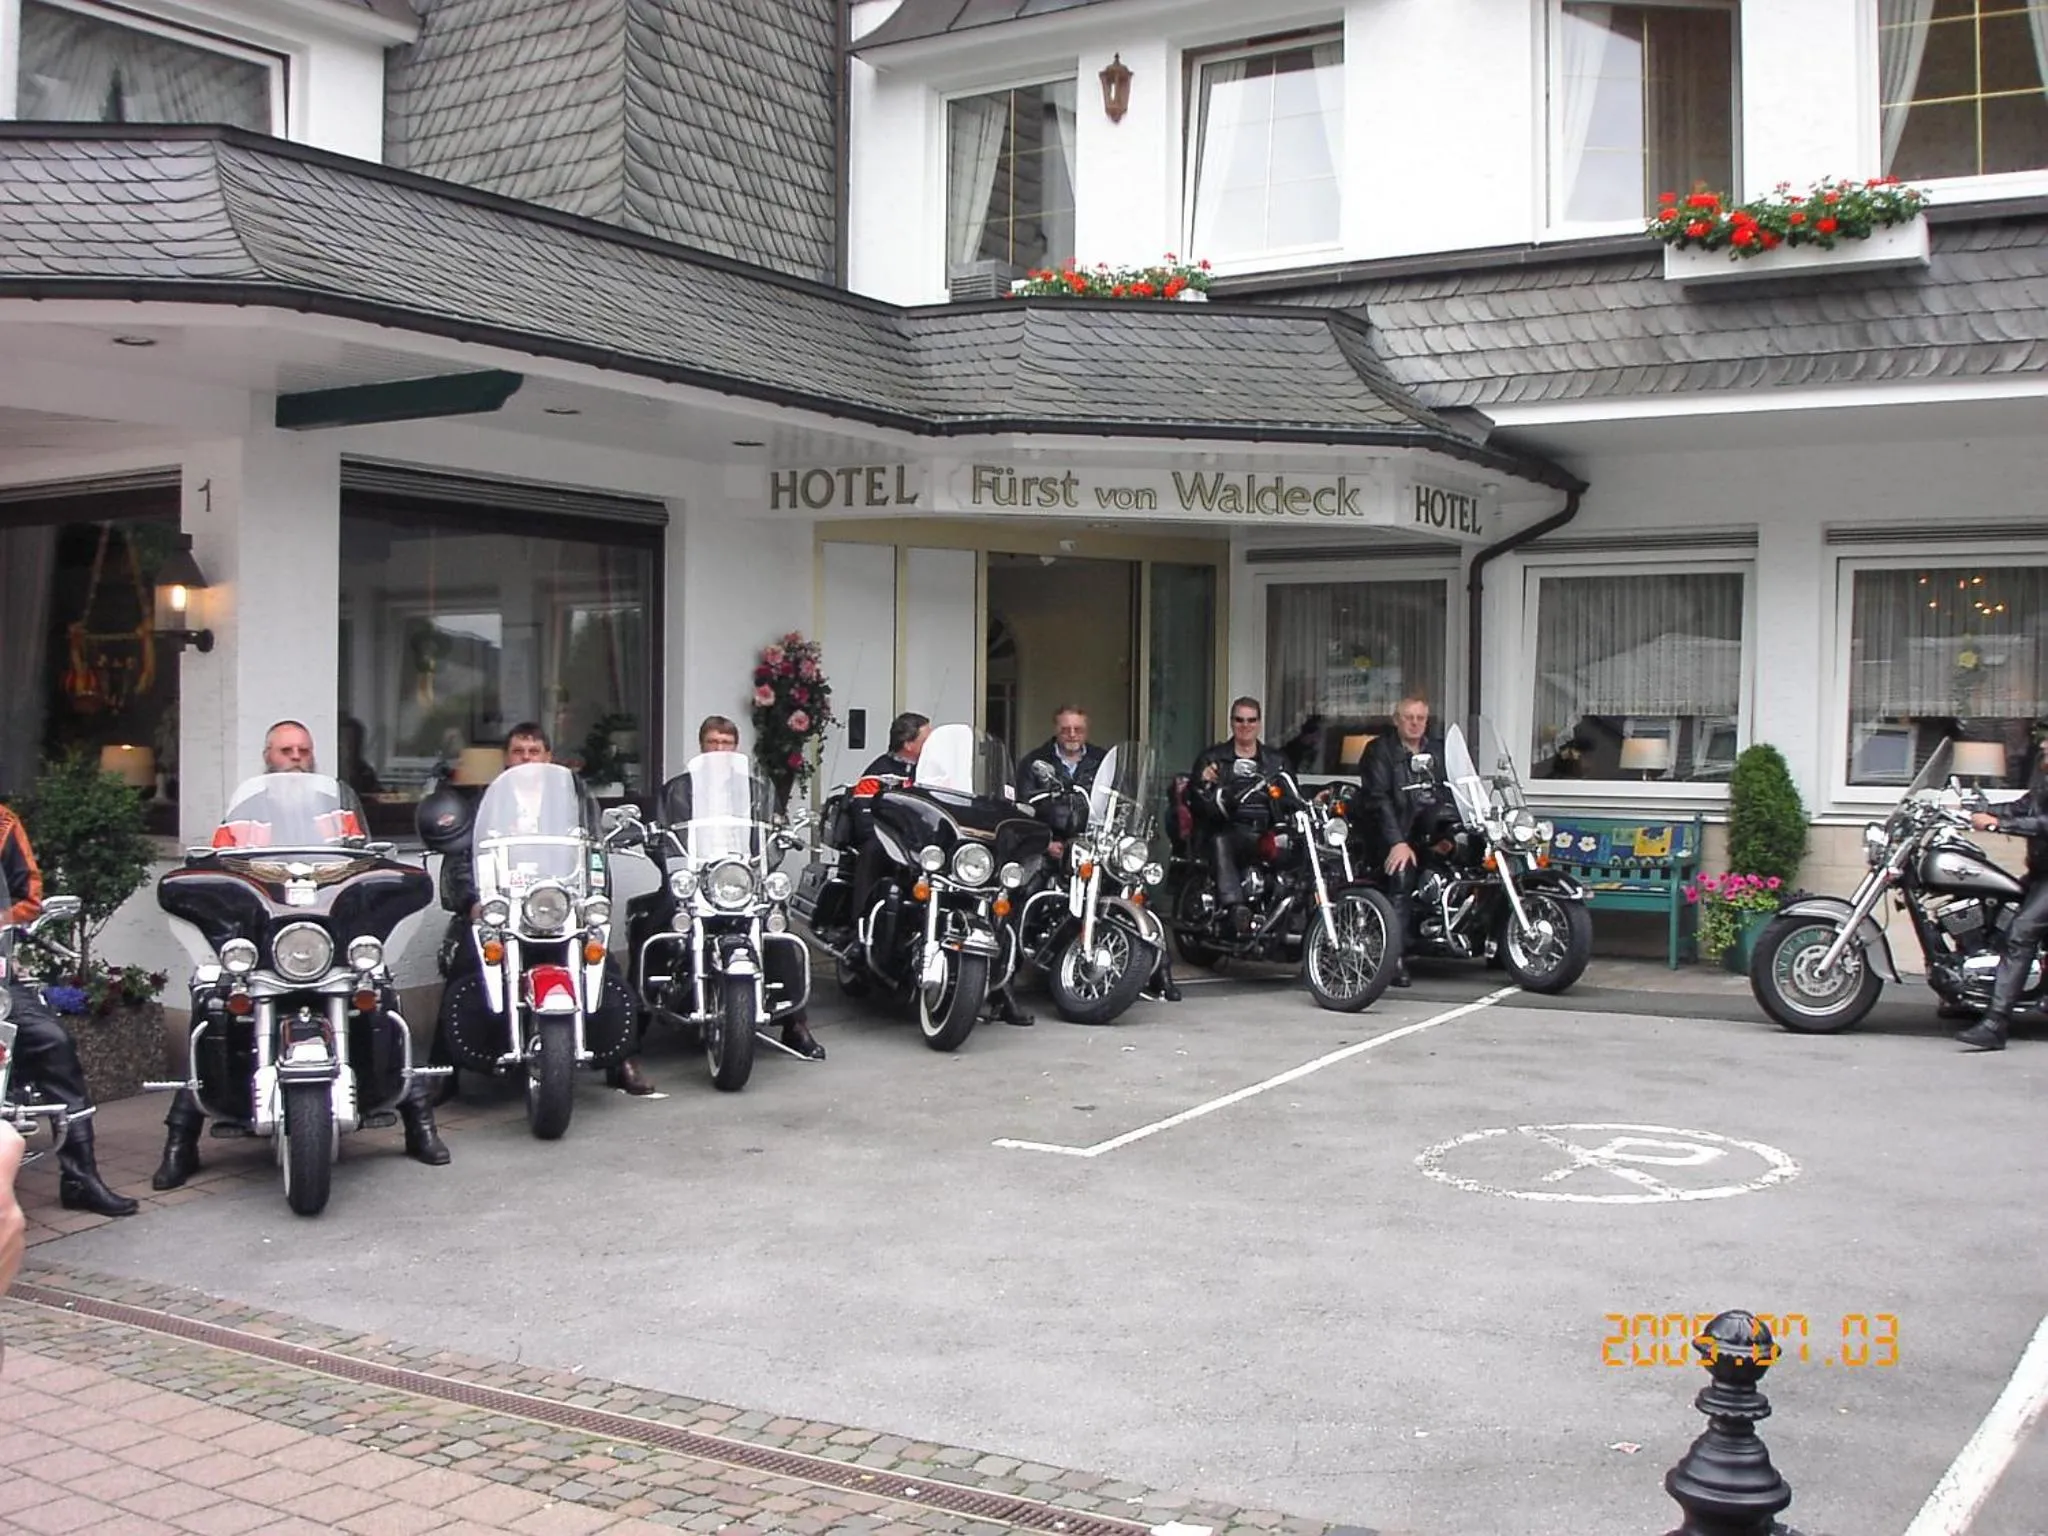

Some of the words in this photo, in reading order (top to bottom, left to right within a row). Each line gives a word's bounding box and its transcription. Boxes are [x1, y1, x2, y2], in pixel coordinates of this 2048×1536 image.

[197, 478, 211, 512] 1
[770, 463, 919, 510] HOTEL
[972, 464, 1079, 508] Fürst
[1094, 487, 1157, 510] von
[1171, 470, 1364, 517] Waldeck
[1415, 485, 1482, 536] HOTEL
